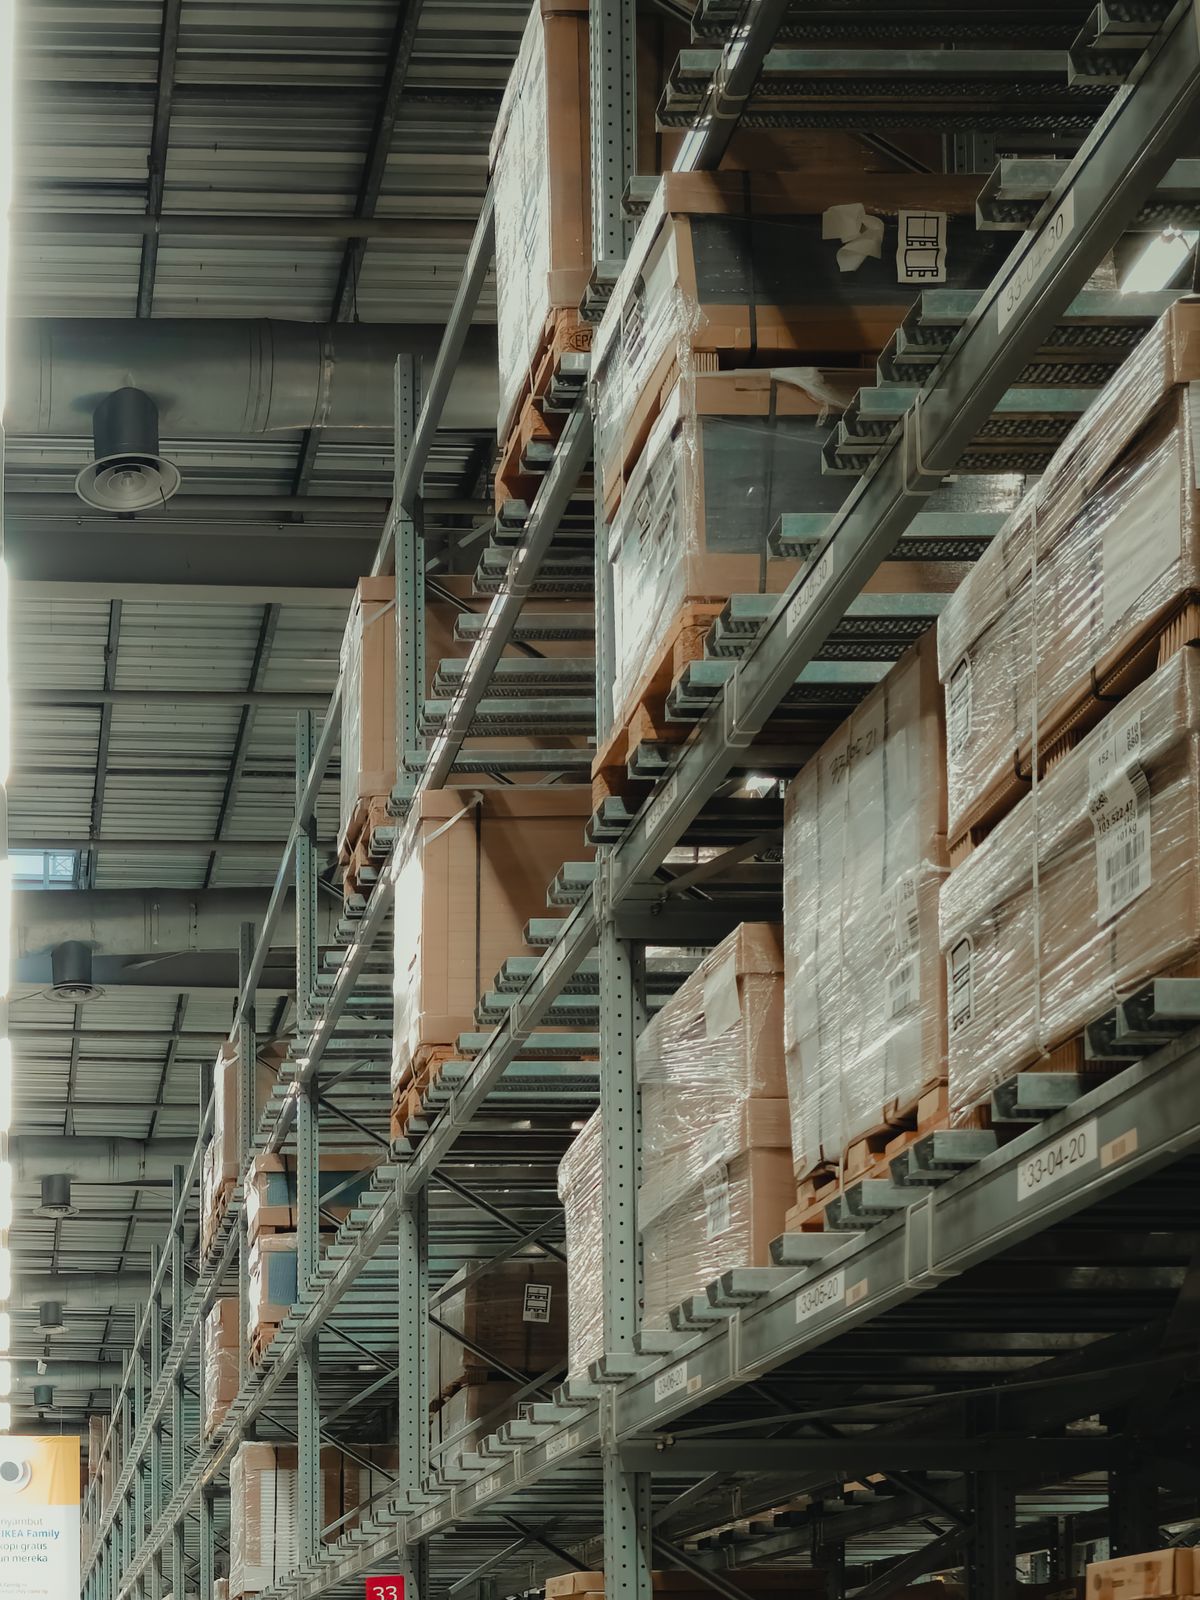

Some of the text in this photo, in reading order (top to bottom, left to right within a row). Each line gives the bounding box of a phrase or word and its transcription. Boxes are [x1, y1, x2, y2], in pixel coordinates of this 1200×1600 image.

[1004, 213, 1065, 315] 33-04-30
[1026, 1132, 1087, 1188] 33-04-20
[801, 1276, 839, 1315] 33-05-20
[1, 1529, 24, 1538] IKEA
[26, 1529, 60, 1540] Family
[20, 1541, 48, 1553] gratis
[12, 1553, 48, 1563] mereka
